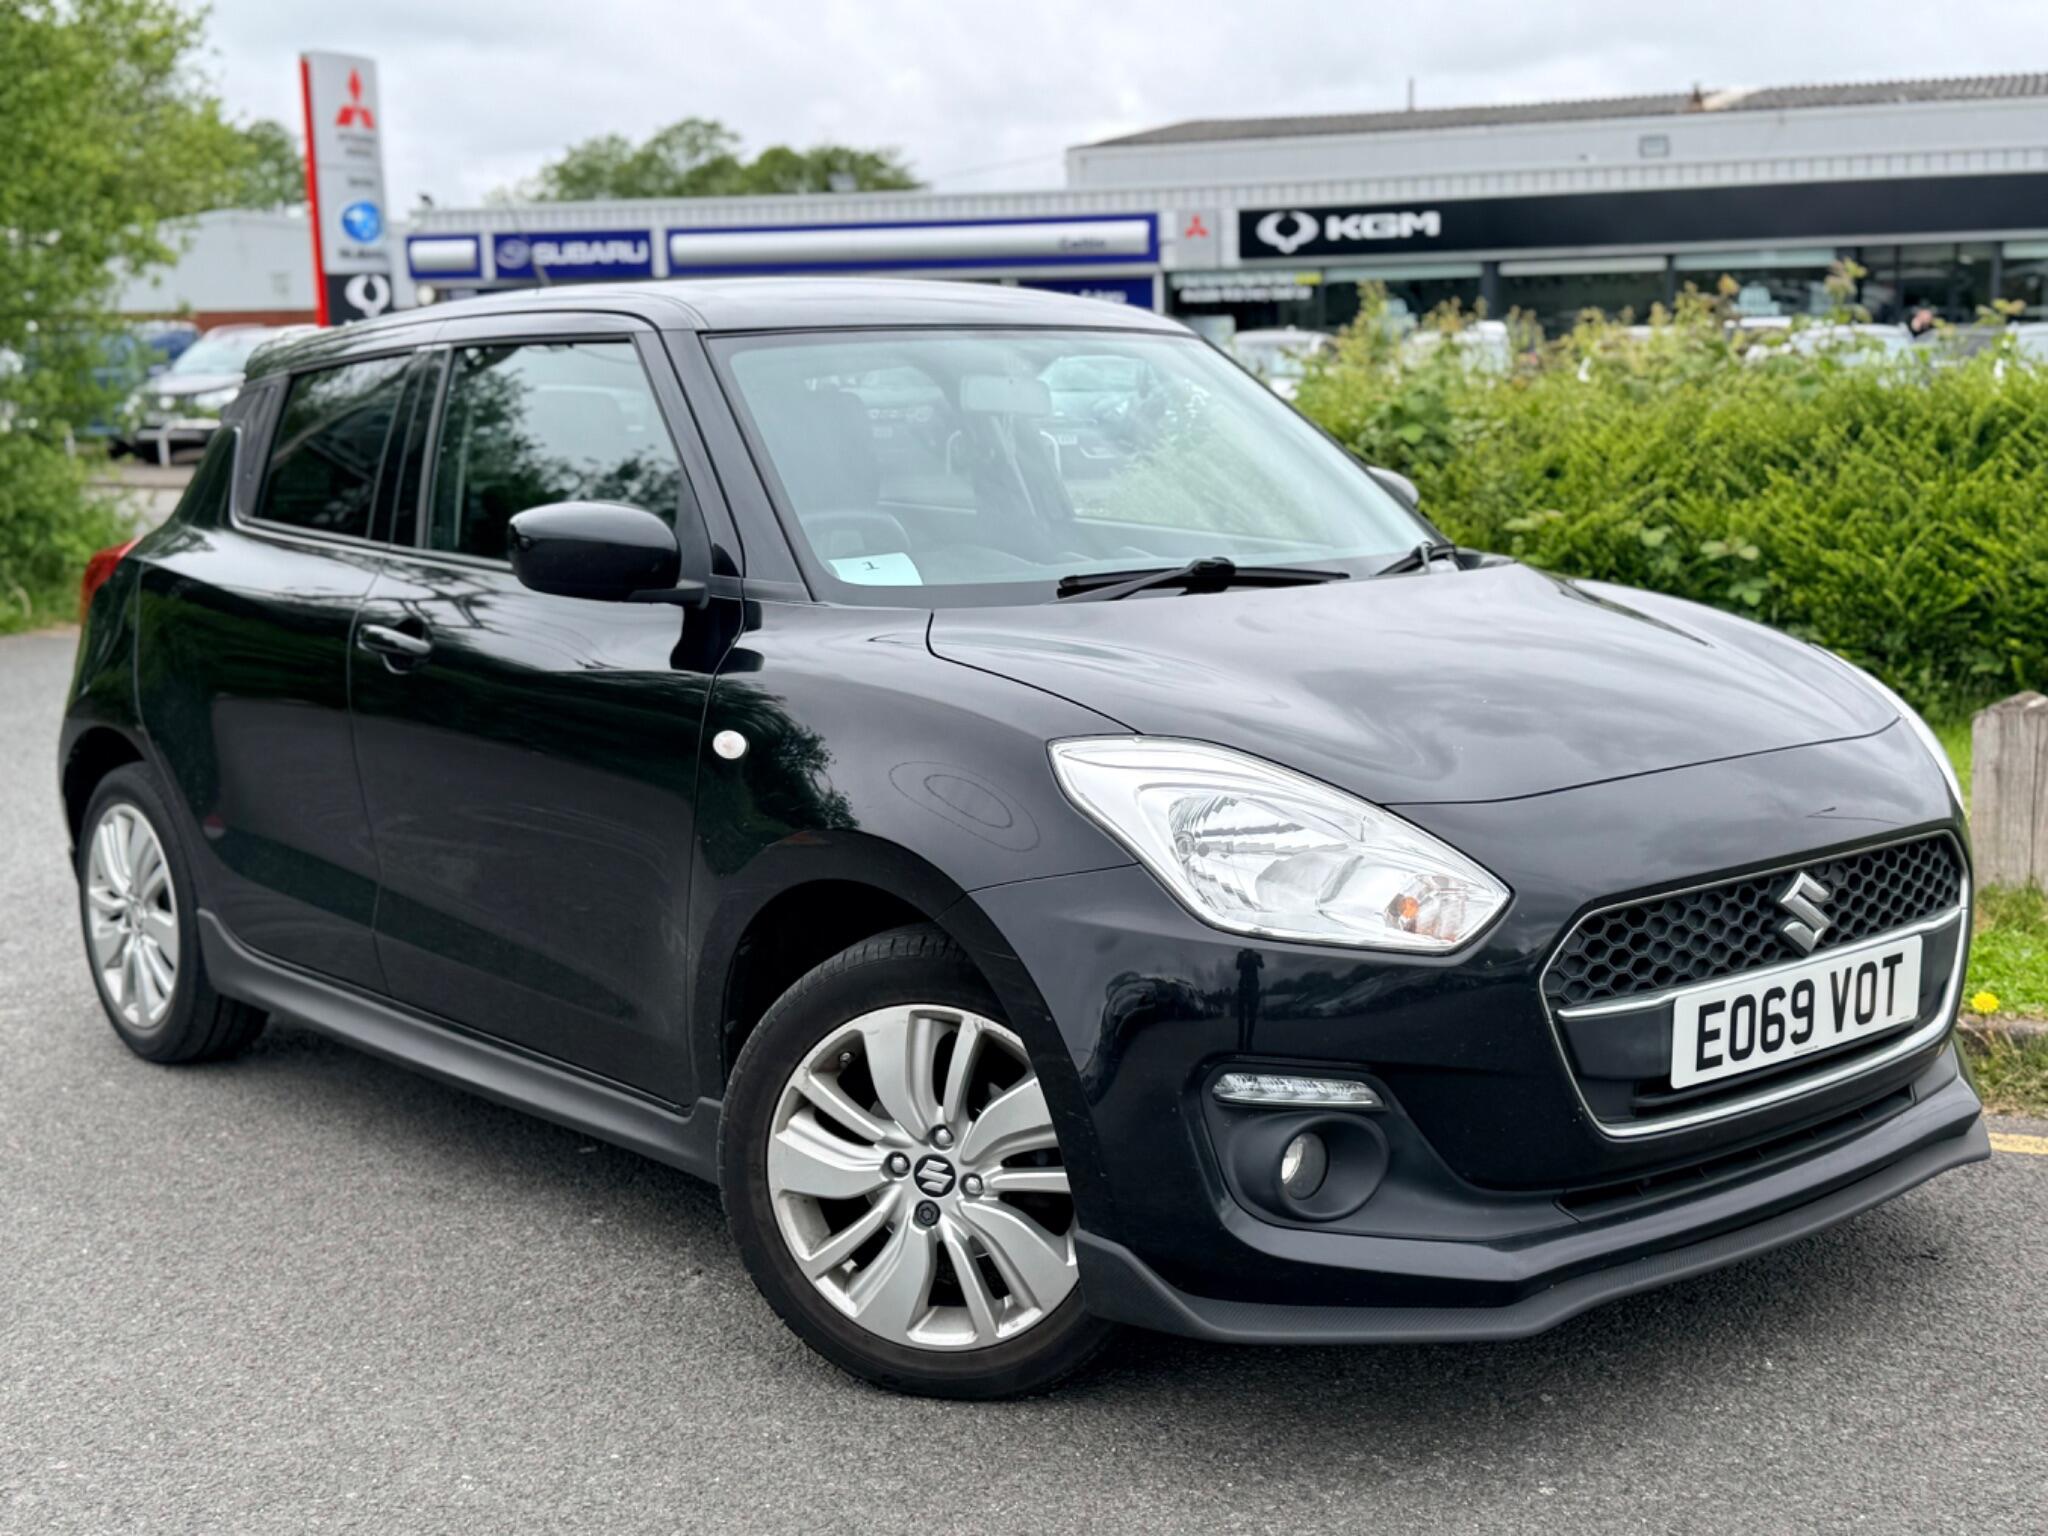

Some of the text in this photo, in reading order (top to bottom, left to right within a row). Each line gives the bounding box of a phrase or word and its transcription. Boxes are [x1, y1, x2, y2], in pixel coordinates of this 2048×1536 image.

[1325, 211, 1441, 242] KGM
[531, 239, 649, 266] SUBARU
[1695, 952, 1904, 1072] EO69 VOT
